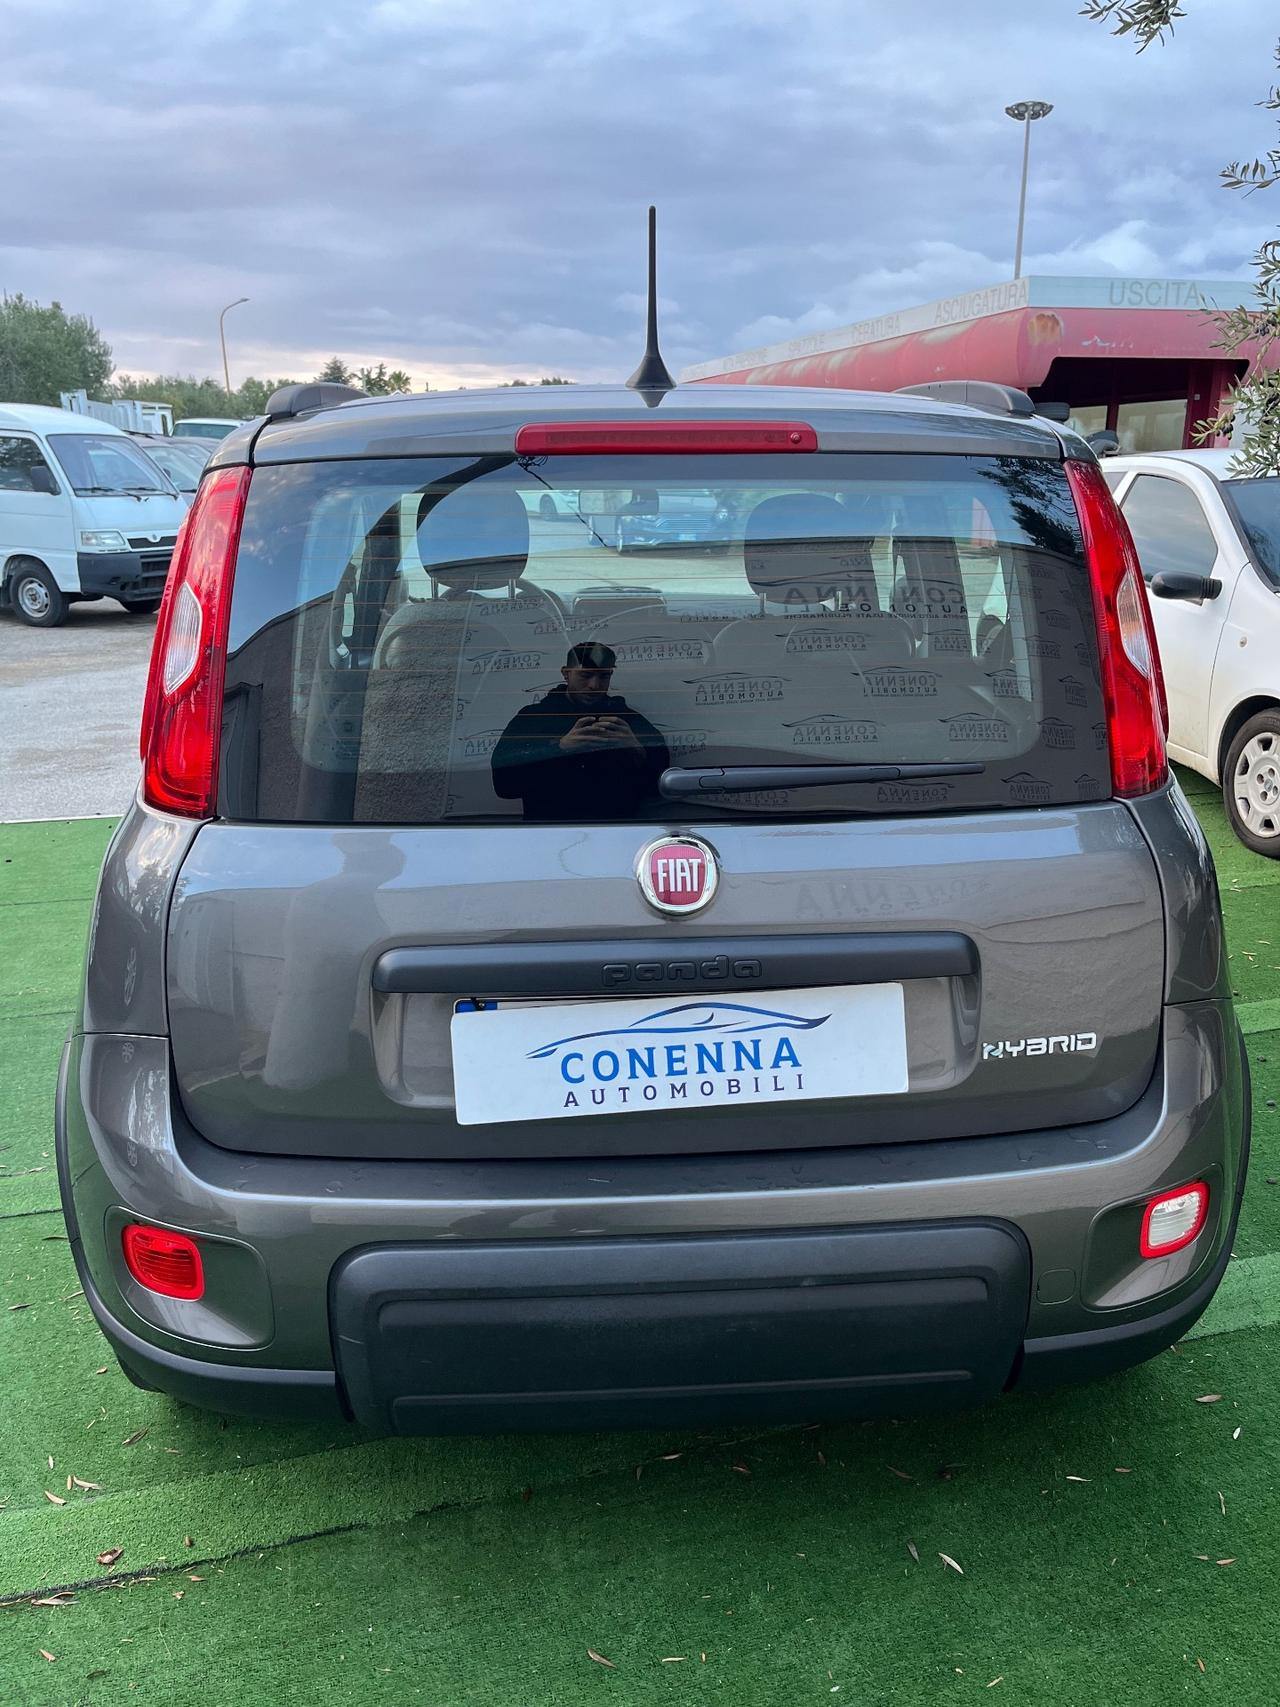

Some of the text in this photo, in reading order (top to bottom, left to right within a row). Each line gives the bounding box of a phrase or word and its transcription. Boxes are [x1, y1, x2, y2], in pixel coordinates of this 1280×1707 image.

[934, 278, 1027, 325] ASCIUGATURA
[1109, 280, 1201, 306] USCITA
[657, 858, 701, 892] FIAT
[601, 954, 762, 987] panda
[560, 1037, 802, 1083] CONENNA
[982, 1032, 1097, 1060] HYBRID
[563, 1073, 804, 1107] AUTOMOBILI
